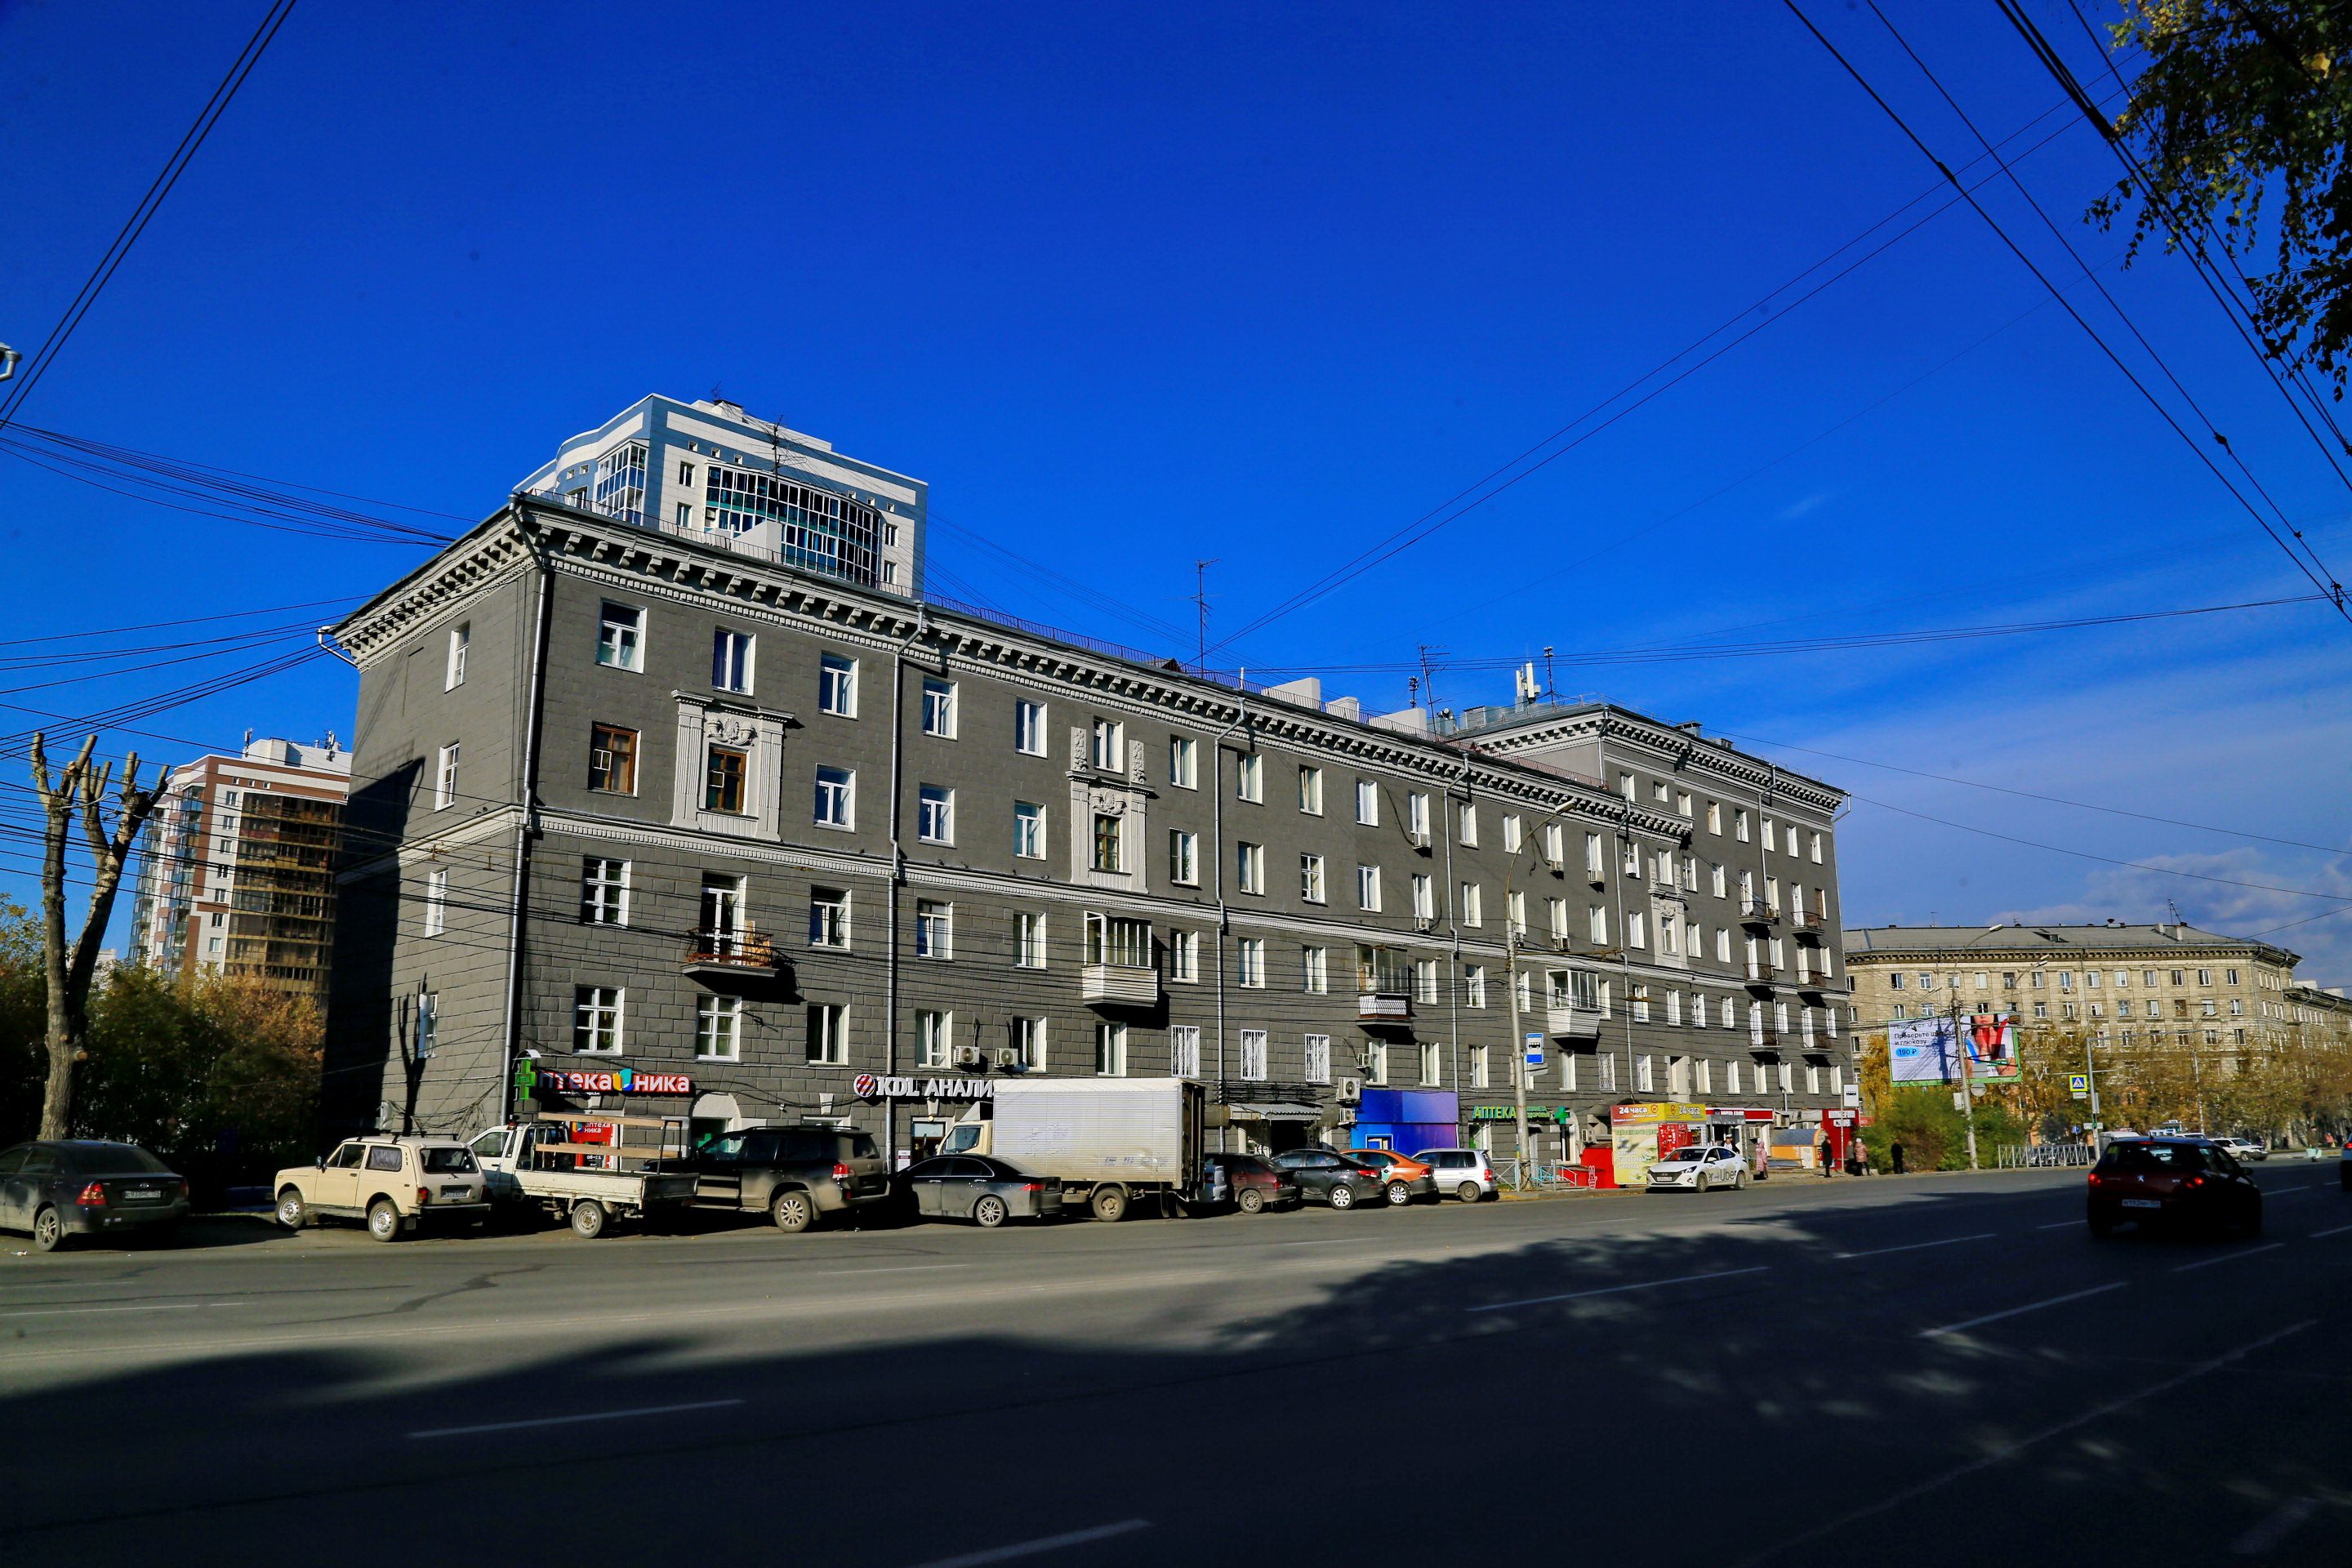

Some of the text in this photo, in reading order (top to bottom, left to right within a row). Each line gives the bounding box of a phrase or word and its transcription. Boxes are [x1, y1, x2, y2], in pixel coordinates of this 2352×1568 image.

[539, 1071, 689, 1093] птека ника
[876, 1076, 994, 1098] KDL АНАЛИ
[1472, 1105, 1517, 1119] АПТЕКА
[1619, 1107, 1629, 1115] 24
[1679, 1105, 1686, 1115] 24
[1720, 1169, 1737, 1182] Uber
